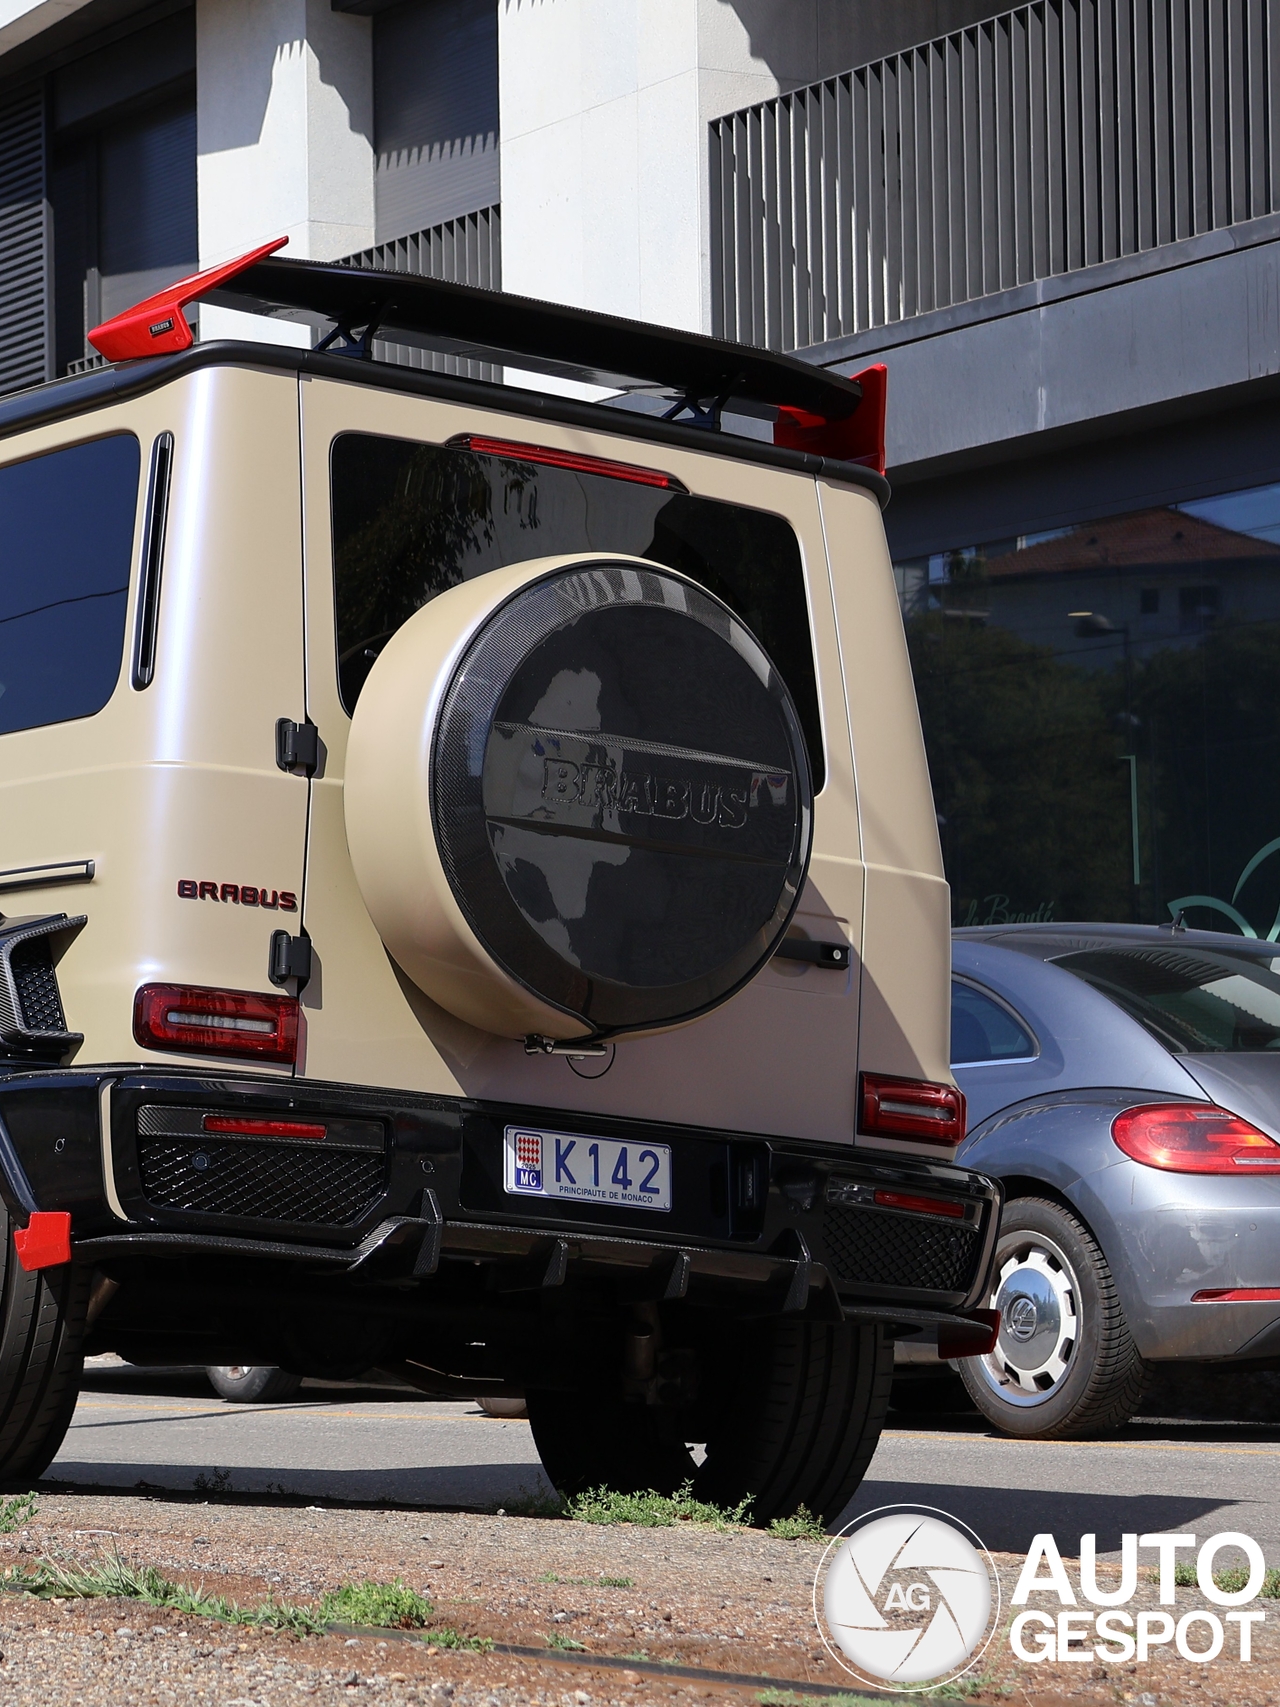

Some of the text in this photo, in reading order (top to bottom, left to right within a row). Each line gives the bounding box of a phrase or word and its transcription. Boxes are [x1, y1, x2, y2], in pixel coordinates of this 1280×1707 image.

[541, 757, 749, 829] BRABUS
[177, 878, 298, 911] BRABUS
[520, 1171, 537, 1186] MC
[554, 1138, 661, 1195] K142
[559, 1185, 653, 1203] PRINCIPAUTE DE MONACO
